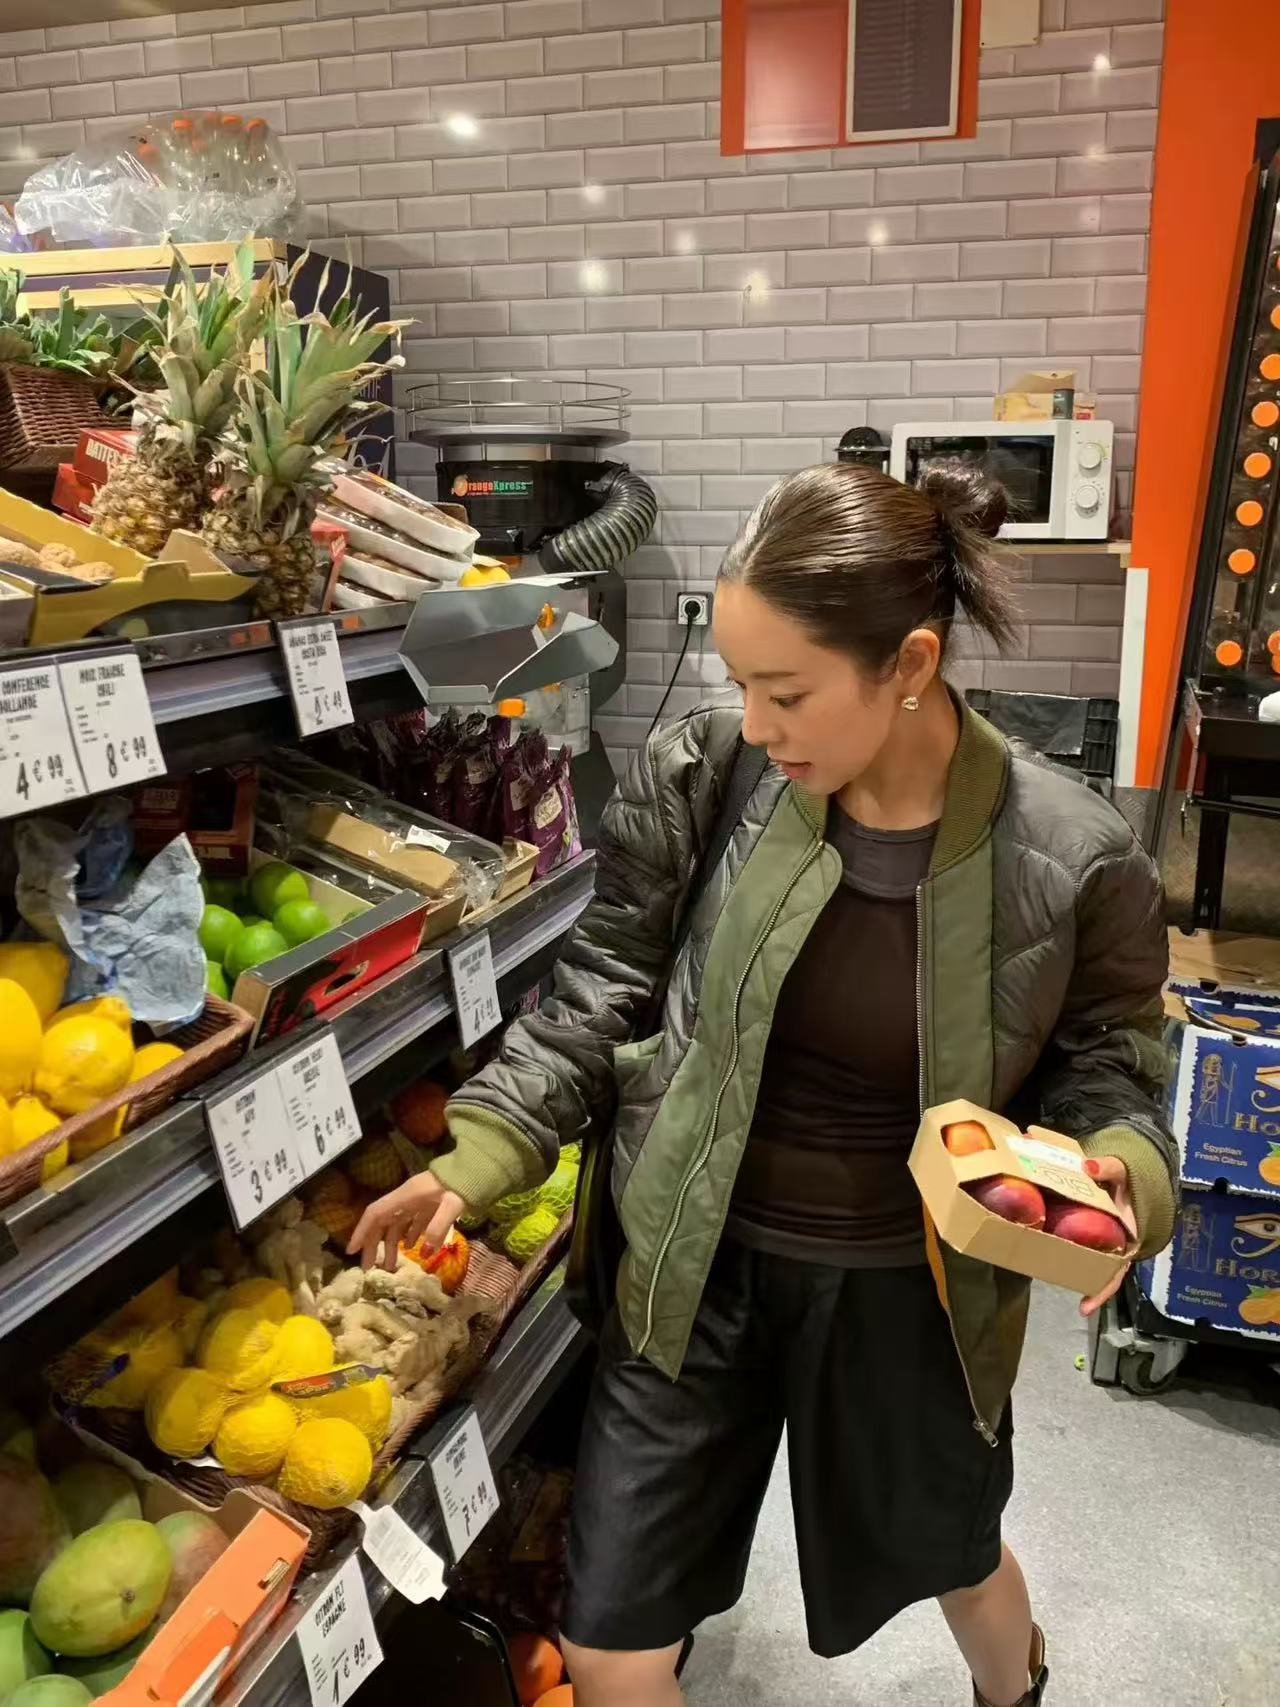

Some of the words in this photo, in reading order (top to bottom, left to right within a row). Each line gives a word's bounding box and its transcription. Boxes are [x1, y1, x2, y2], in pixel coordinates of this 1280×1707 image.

[16, 761, 30, 800] 4
[47, 754, 64, 779] 99
[106, 742, 118, 778] 8
[132, 735, 148, 760] 99
[314, 1122, 326, 1157] 6
[1194, 1151, 1220, 1162] Fresh
[1220, 1156, 1248, 1167] Citrus
[1203, 1142, 1242, 1156] Egyptian
[251, 1169, 264, 1204] 3
[274, 1148, 287, 1175] 99
[315, 1593, 334, 1627] CITRON
[322, 1597, 346, 1638] ESPAGNE
[332, 1669, 340, 1705] 1
[353, 1637, 365, 1665] 99
